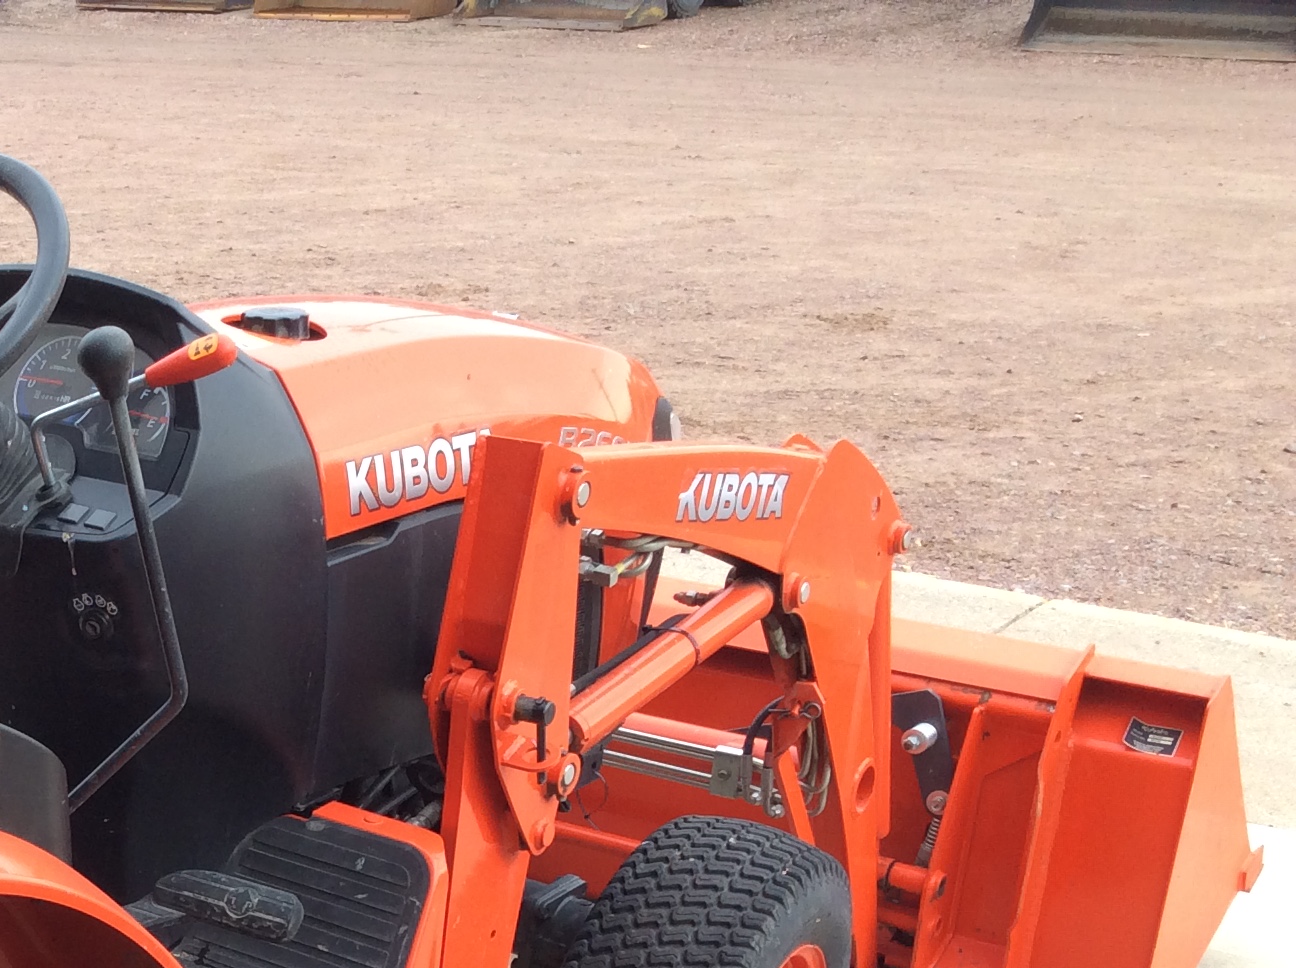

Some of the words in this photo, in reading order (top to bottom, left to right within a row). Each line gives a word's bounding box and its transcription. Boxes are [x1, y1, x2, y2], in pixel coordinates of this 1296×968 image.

[139, 388, 151, 400] F
[146, 418, 156, 428] E
[558, 426, 631, 448] B26
[345, 428, 492, 516] KUBOT
[675, 471, 790, 523] KUBOTA
